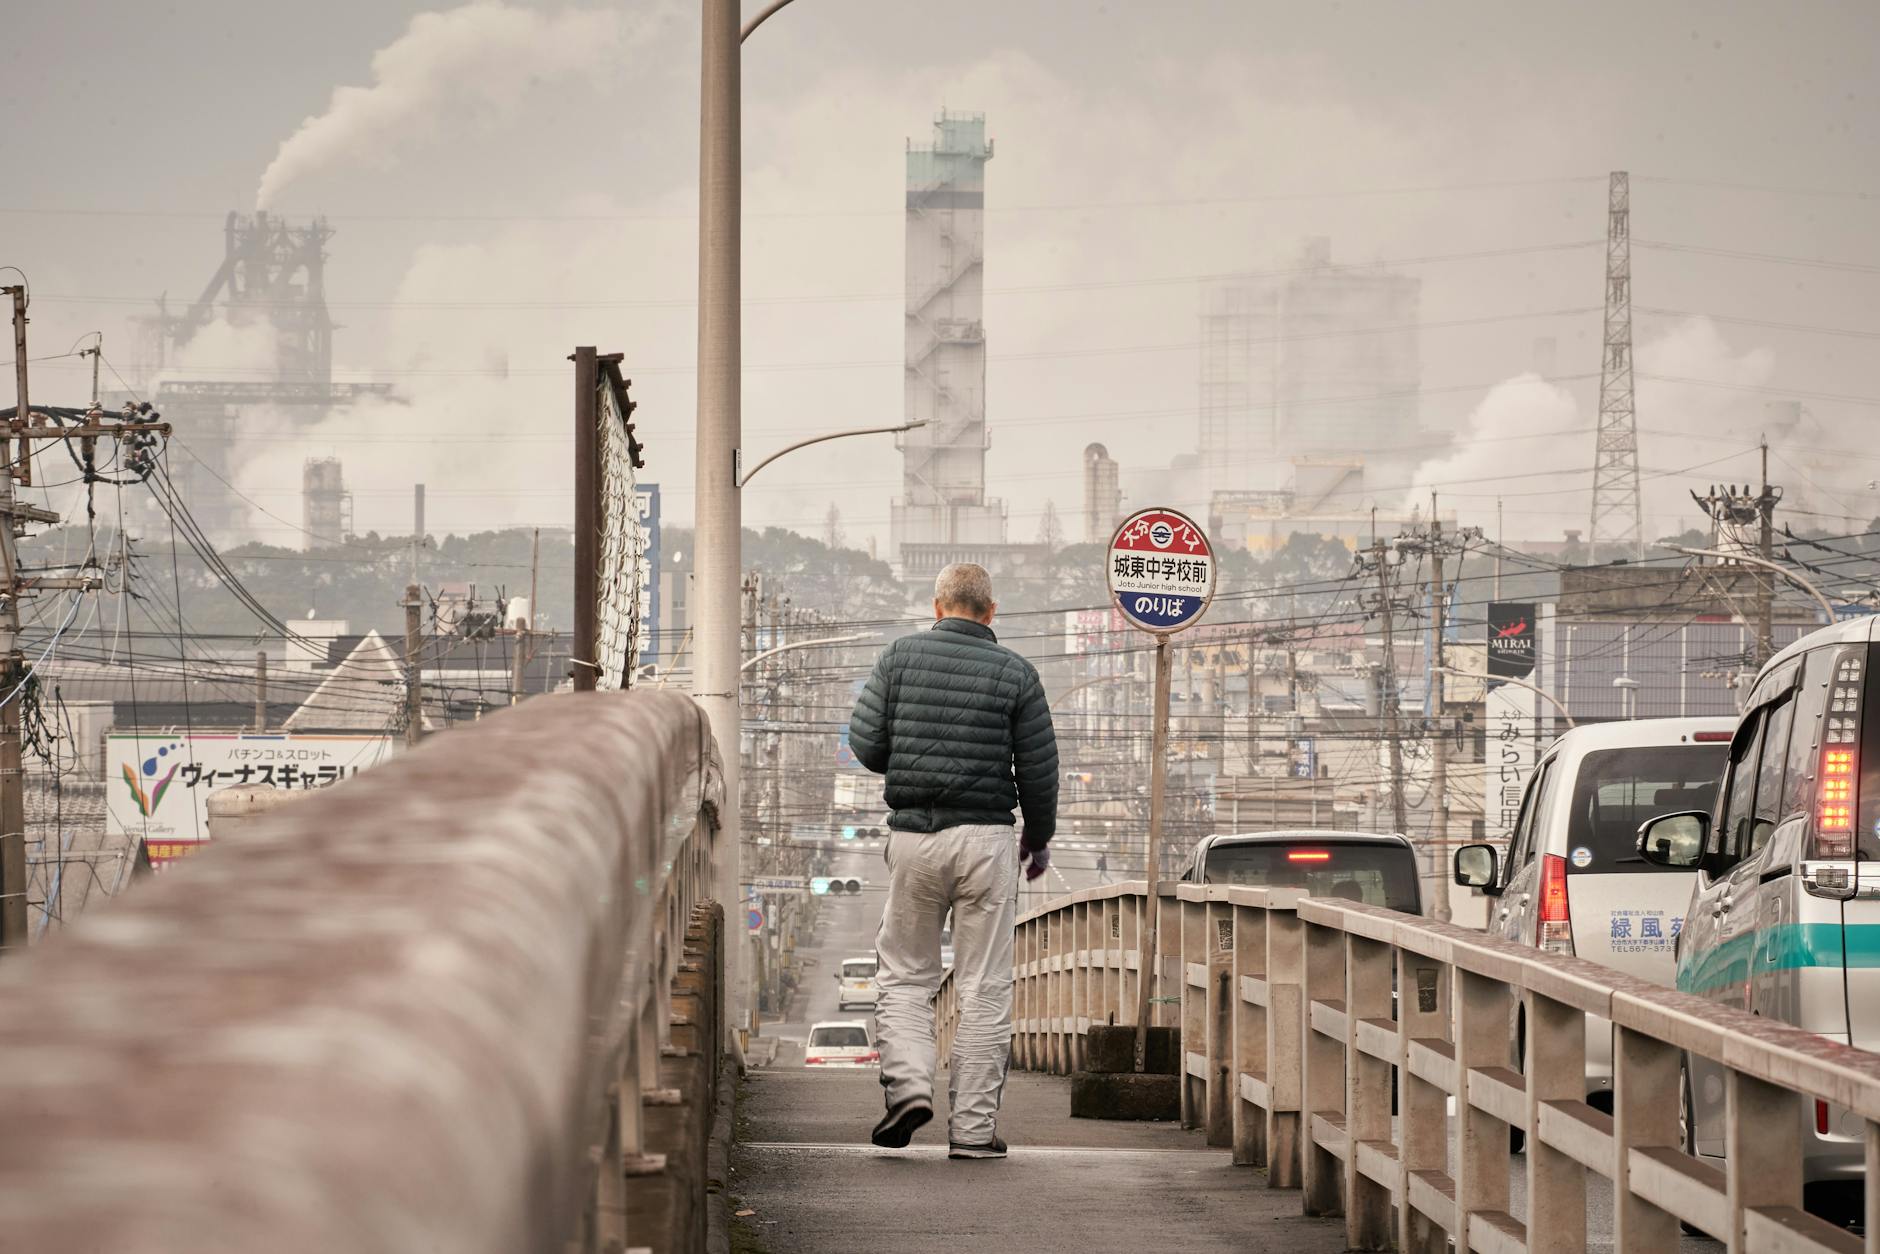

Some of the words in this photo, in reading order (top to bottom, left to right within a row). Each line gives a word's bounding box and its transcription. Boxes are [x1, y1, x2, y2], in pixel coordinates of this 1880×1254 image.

[1123, 519, 1150, 547] 大分
[1173, 523, 1200, 552] バス
[1114, 555, 1207, 583] 城東中学校前
[1118, 580, 1135, 588] Joto
[1137, 581, 1160, 590] Junior
[1161, 583, 1177, 592] high
[1178, 585, 1202, 593] school
[1135, 596, 1185, 617] のりば
[1491, 639, 1531, 649] MIRAI
[1500, 710, 1522, 720] 大分
[1500, 722, 1521, 877] みらい信用
